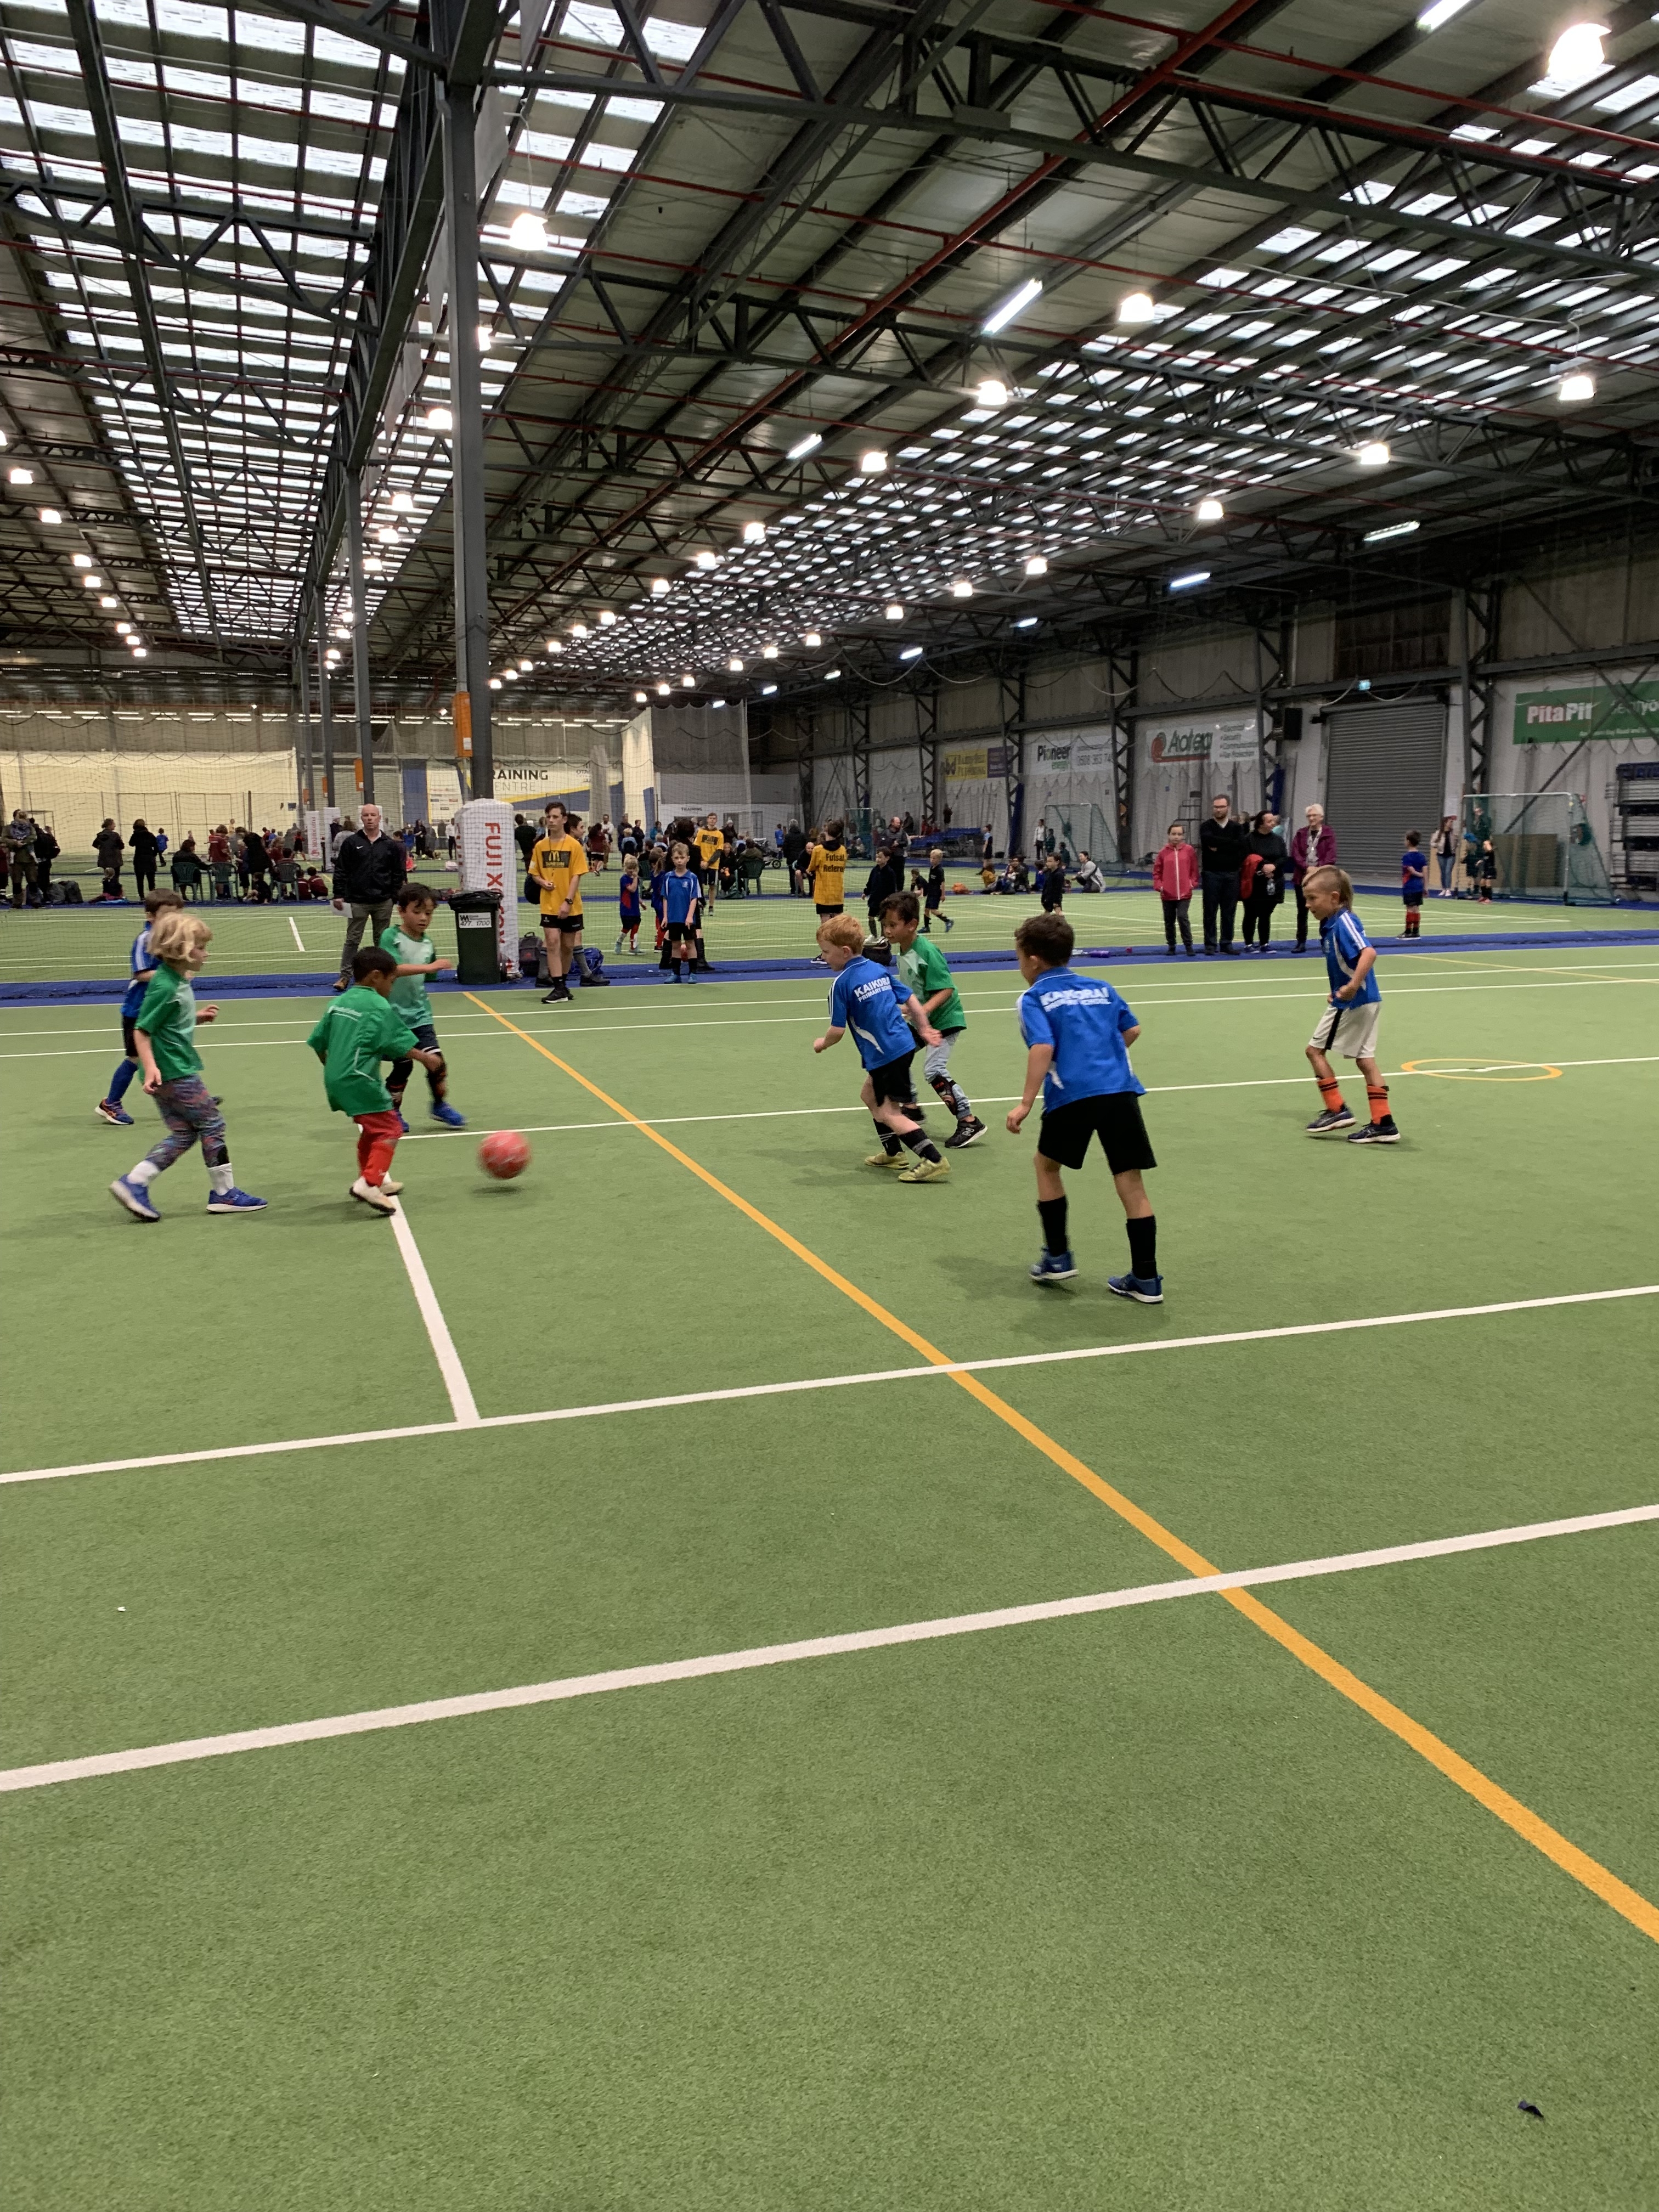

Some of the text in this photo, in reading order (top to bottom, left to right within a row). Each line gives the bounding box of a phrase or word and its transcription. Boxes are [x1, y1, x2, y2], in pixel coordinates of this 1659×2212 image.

[1037, 744, 1071, 762] Pioneer
[495, 782, 535, 791] ENTRE
[485, 822, 503, 866] FUJI
[826, 853, 844, 861] Futsal
[854, 977, 891, 997] KAIKORA
[857, 987, 882, 1002] PRIMARY
